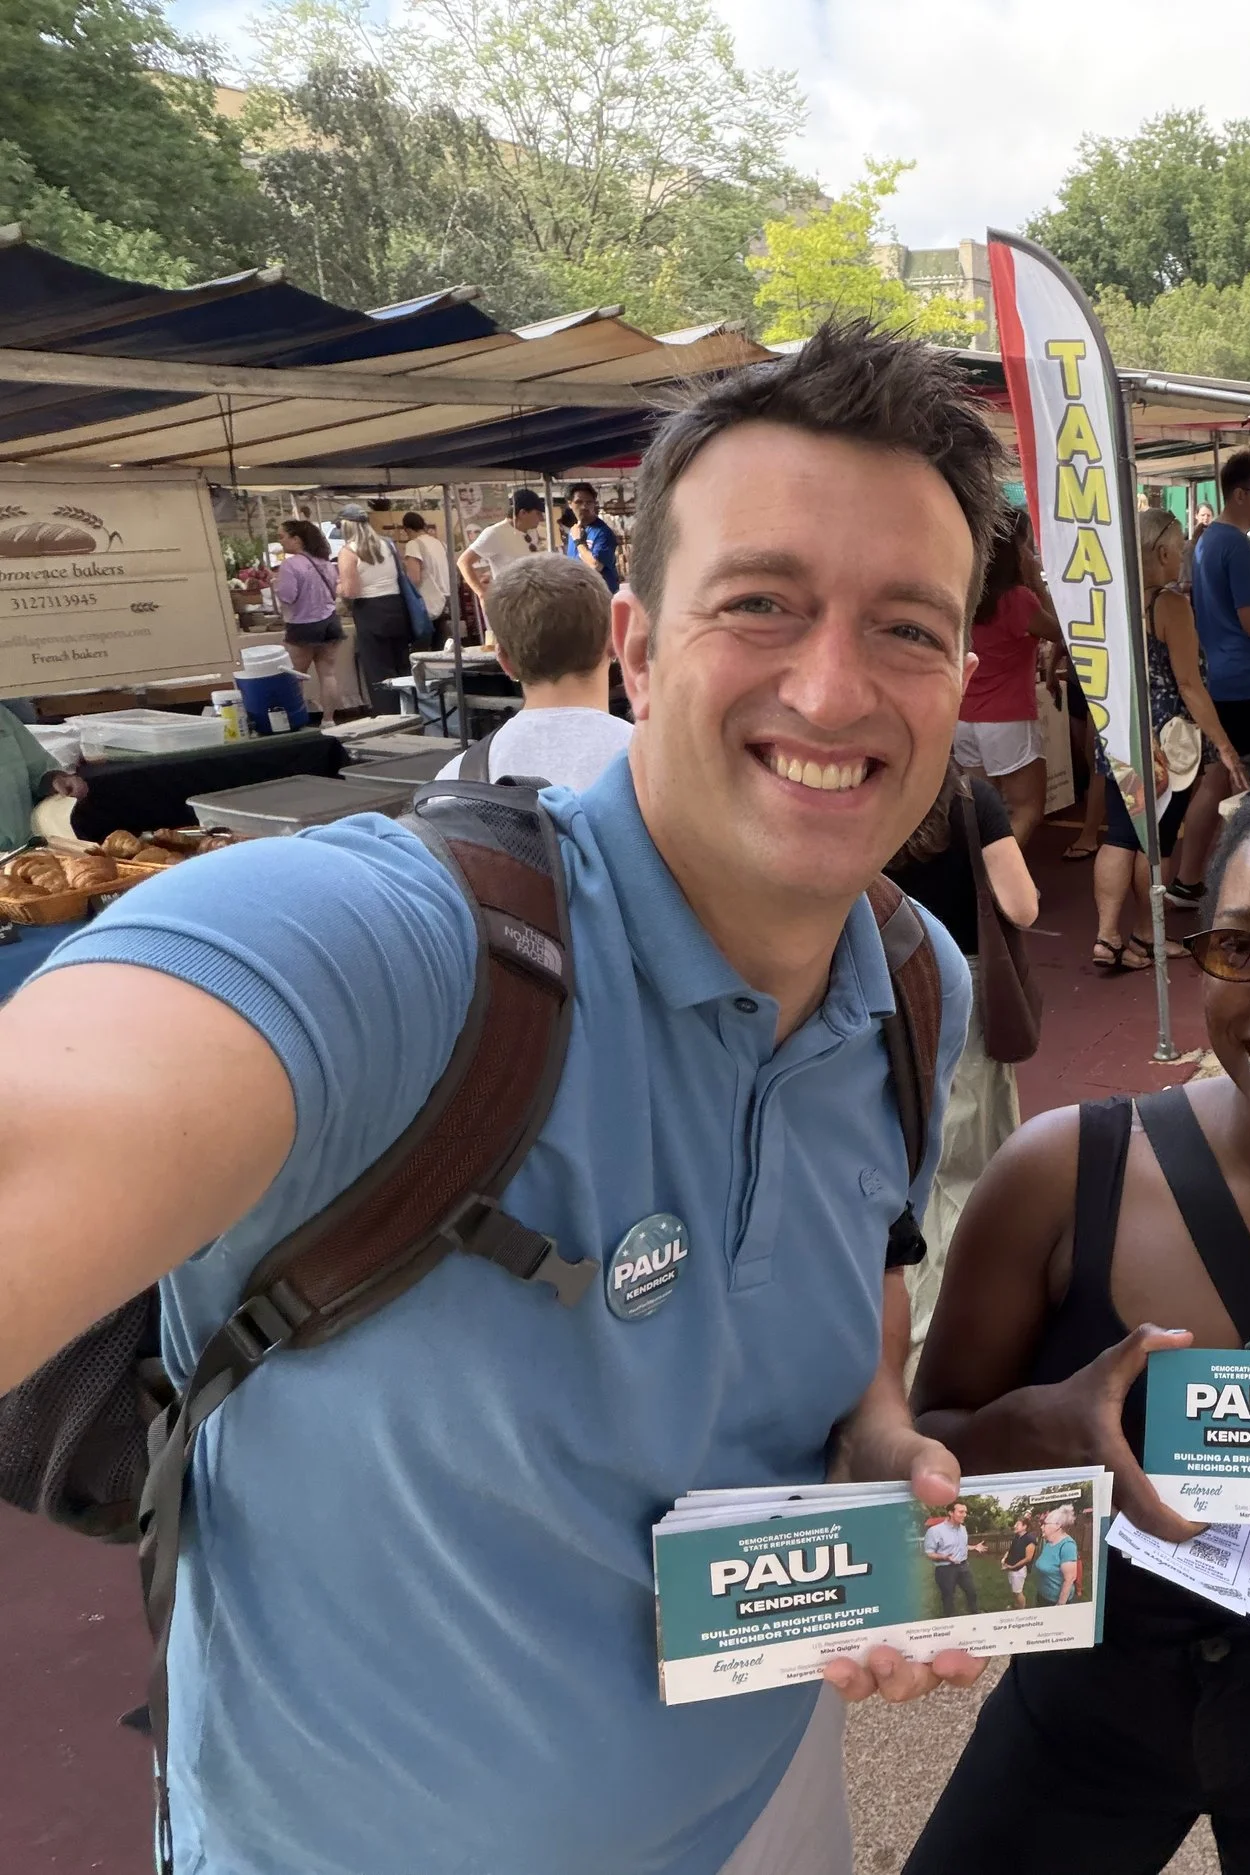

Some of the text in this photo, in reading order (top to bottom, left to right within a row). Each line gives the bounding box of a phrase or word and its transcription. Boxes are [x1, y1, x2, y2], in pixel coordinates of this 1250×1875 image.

[72, 562, 124, 577] bakers
[11, 594, 97, 610] 3127313945
[32, 649, 108, 664] French bakers
[504, 926, 545, 954] NORTH
[523, 926, 544, 944] THE
[516, 942, 544, 965] FACE
[614, 1239, 688, 1290] PAUL
[626, 1271, 675, 1301] KENDRICK
[1174, 1453, 1221, 1461] BUILDING
[1187, 1464, 1239, 1473] NEIGHBOR
[1180, 1483, 1223, 1496] Endorsed
[1193, 1498, 1208, 1512] by:
[739, 1524, 842, 1546] DEMOCRATIC NOMINEE for
[743, 1533, 839, 1552] STATE REPRESENTATIVE
[710, 1542, 870, 1596] PAUL
[740, 1589, 838, 1615] KENDRICK
[701, 1623, 759, 1641] BUILDING
[773, 1613, 832, 1629] BRIGHTER
[834, 1606, 880, 1619] FUTURE
[1008, 1621, 1043, 1630] Feigenholtz
[719, 1618, 864, 1648] NEIGHBOR TO NEIGHBOR
[837, 1643, 860, 1652] Quigley
[713, 1654, 764, 1673] Endorsed
[732, 1671, 749, 1685] by:
[786, 1669, 816, 1679] Margaret
